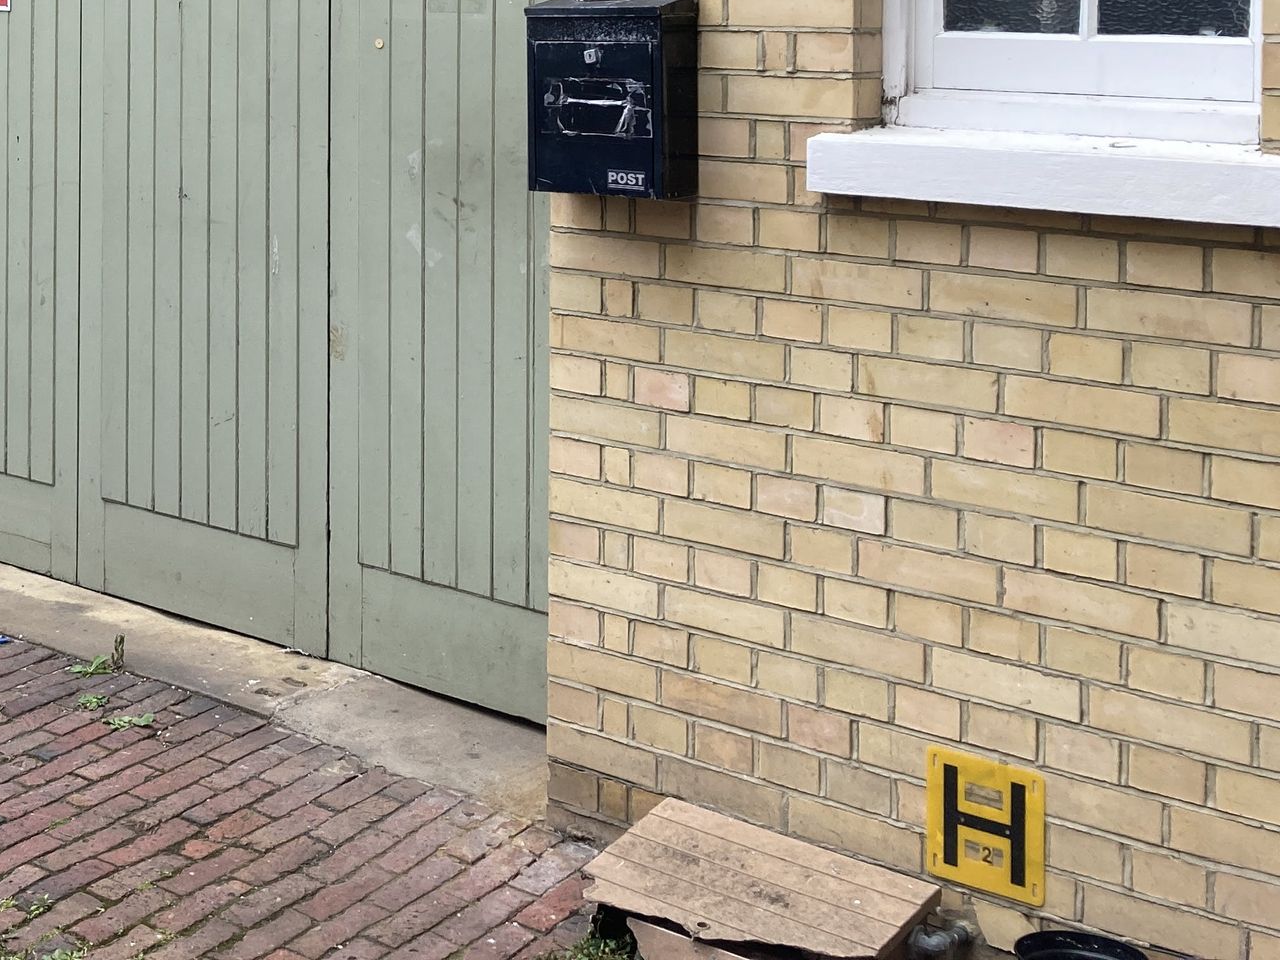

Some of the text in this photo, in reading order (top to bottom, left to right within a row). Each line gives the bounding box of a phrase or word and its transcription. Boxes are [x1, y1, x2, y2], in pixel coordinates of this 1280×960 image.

[608, 171, 645, 185] POST
[943, 763, 1026, 888] H
[981, 846, 993, 864] 2
